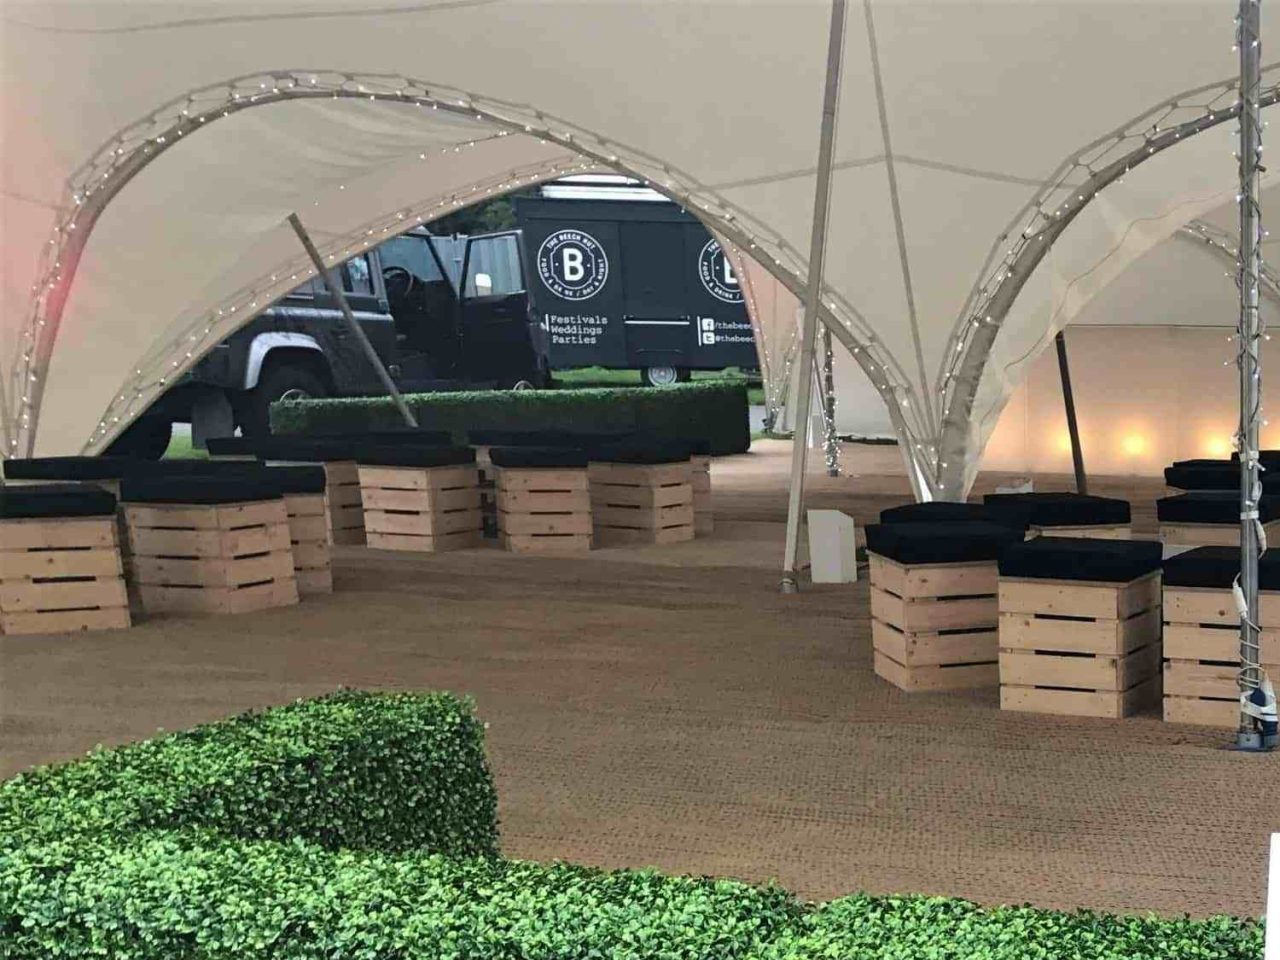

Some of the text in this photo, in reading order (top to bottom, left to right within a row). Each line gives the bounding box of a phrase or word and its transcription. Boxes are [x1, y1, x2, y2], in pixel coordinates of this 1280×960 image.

[559, 233, 581, 241] BEECH
[563, 248, 585, 281] B
[551, 315, 608, 324] Festivals
[551, 325, 602, 335] Weddings
[552, 335, 597, 344] Parties
